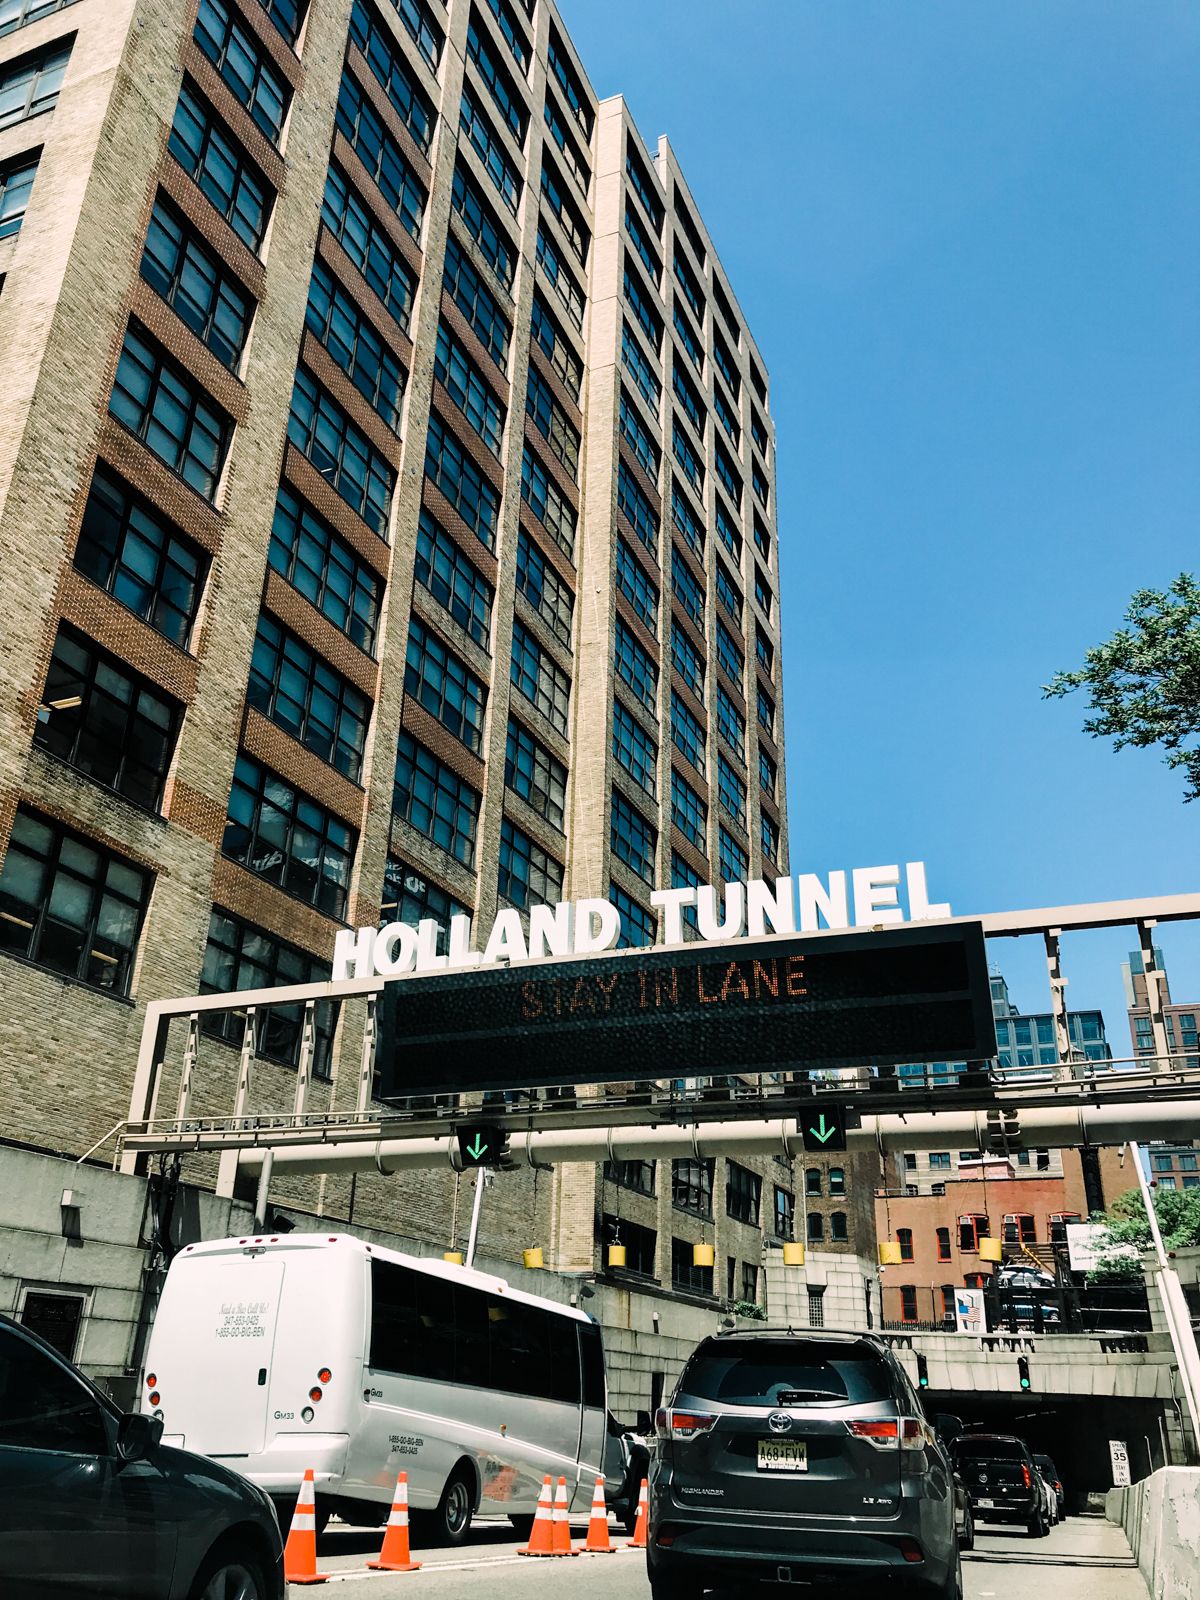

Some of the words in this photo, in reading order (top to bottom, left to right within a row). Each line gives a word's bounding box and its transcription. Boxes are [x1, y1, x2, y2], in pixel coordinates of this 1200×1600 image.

[332, 898, 621, 981] HOLLAND
[650, 861, 950, 945] TUNNEL
[521, 972, 617, 1018] STAY
[638, 967, 678, 1008] IN
[698, 955, 807, 1003] LANE
[215, 1326, 265, 1338] 1-855-GO-BIG-BEN
[1113, 1452, 1127, 1461] 35
